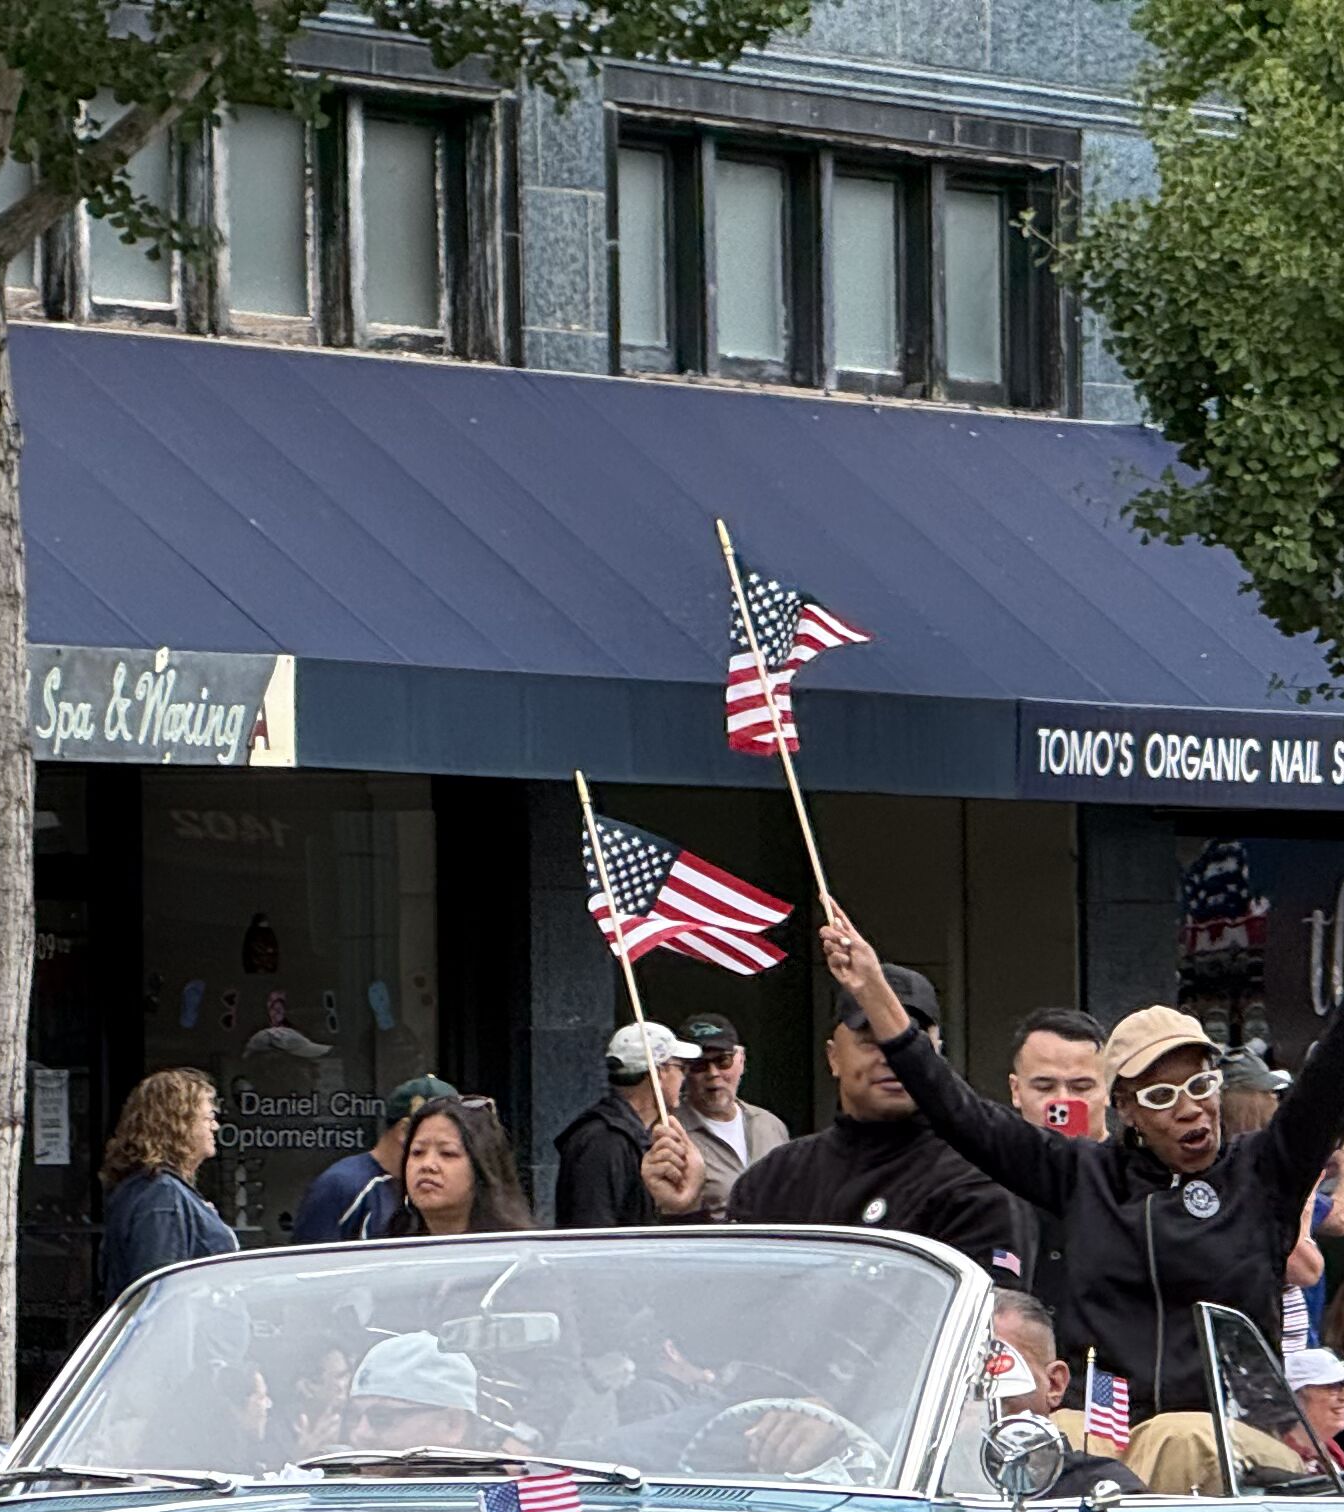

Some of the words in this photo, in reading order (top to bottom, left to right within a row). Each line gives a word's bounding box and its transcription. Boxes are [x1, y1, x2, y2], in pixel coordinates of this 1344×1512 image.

[34, 666, 94, 754] Spa
[104, 661, 133, 743] &
[134, 664, 246, 765] Waxing
[1038, 728, 1135, 778] TOMO'S
[1145, 732, 1261, 784] ORGANIC
[1270, 740, 1323, 784] NAIL
[240, 1091, 318, 1116] Daniel
[330, 1092, 387, 1117] Chin
[217, 1123, 365, 1152] Optometrist
